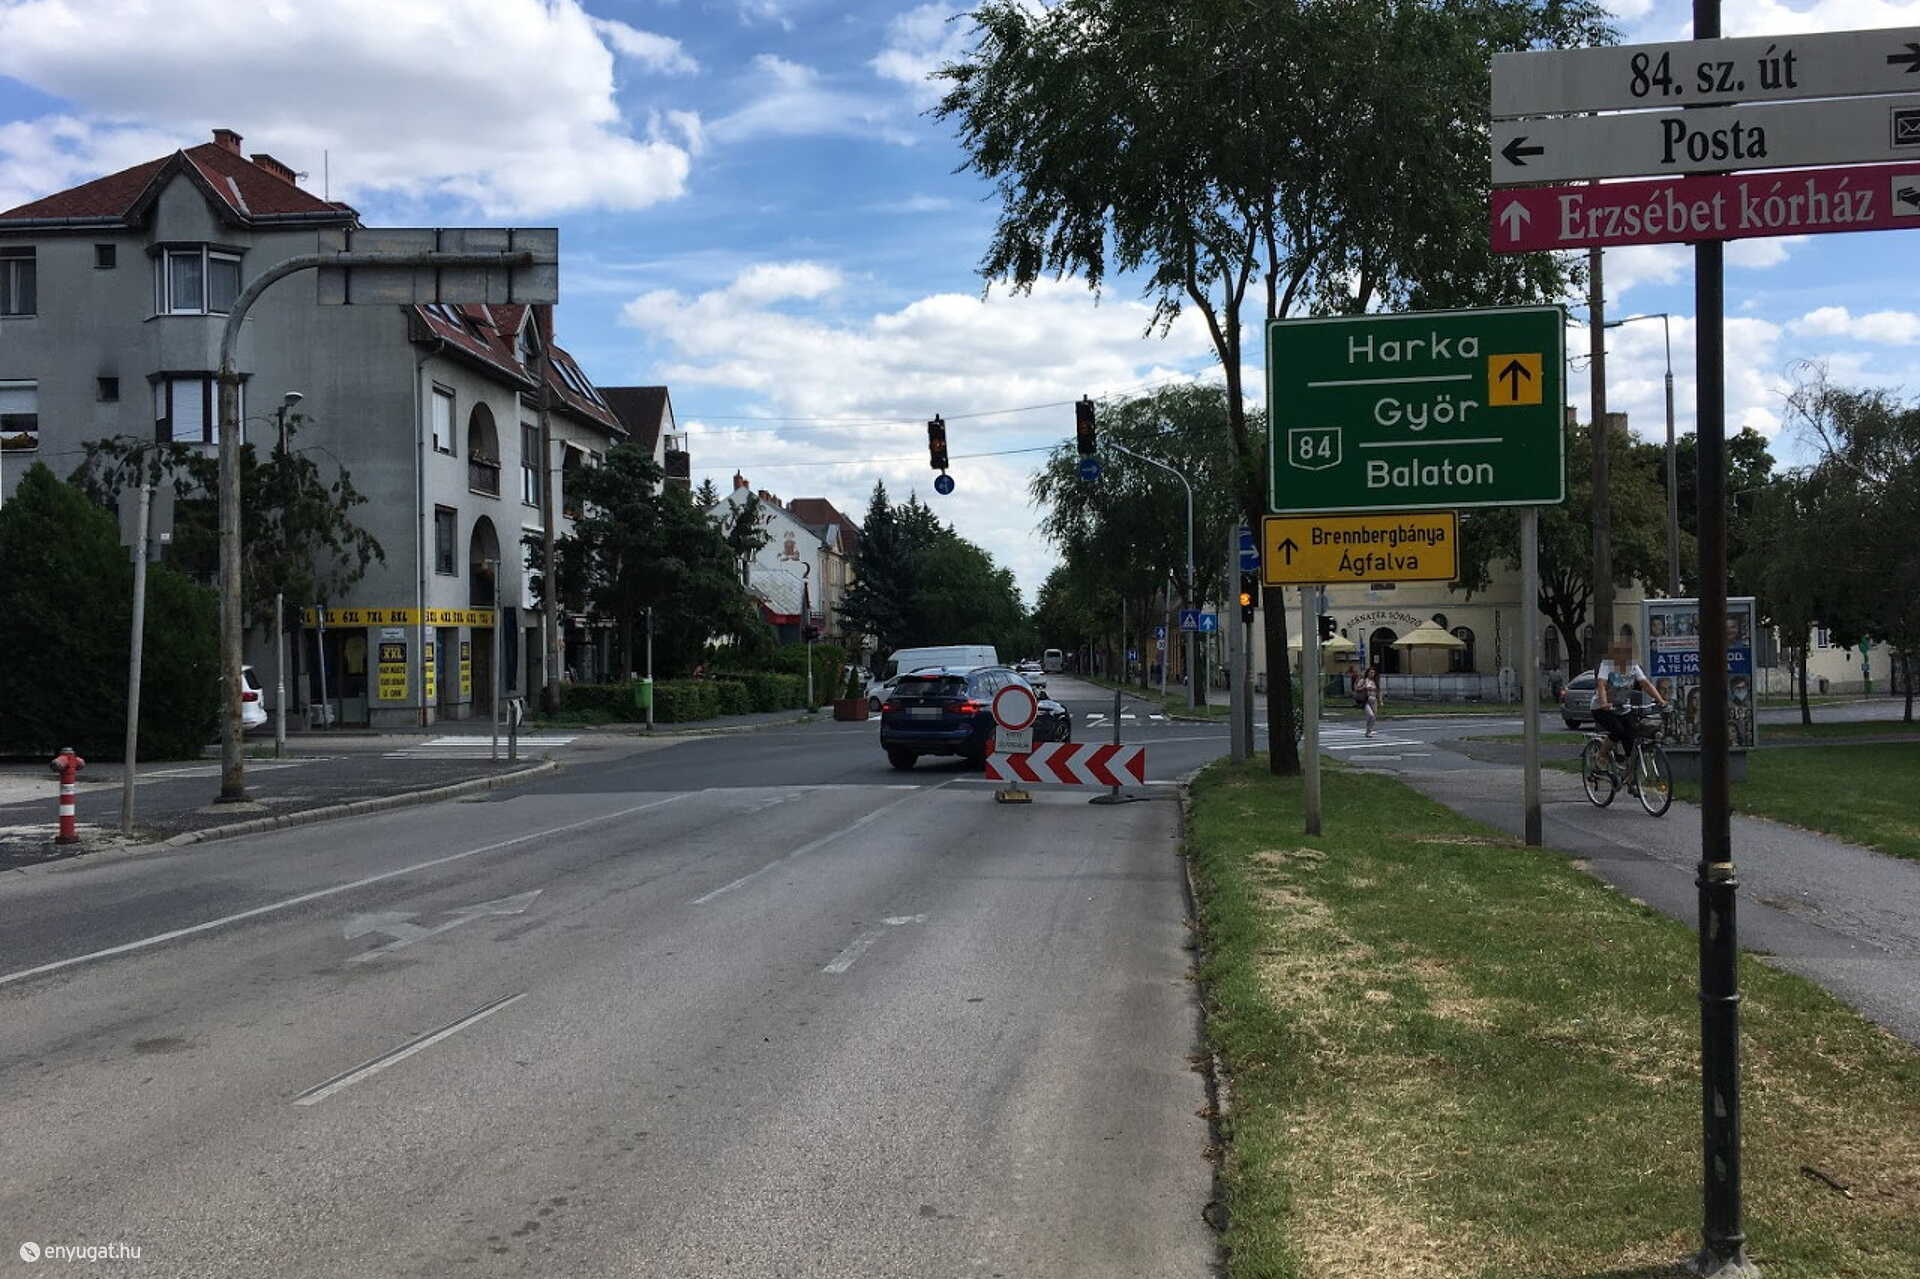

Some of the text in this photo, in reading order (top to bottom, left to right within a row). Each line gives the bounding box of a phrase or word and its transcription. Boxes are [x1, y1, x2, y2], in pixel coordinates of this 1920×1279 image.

[1630, 44, 1797, 98] 84. sz. út
[1661, 118, 1767, 164] Posta
[1558, 176, 1874, 241] Erzsébet kórház
[1348, 331, 1479, 364] Harka
[1299, 435, 1331, 460] 84
[1367, 458, 1494, 489] Balaton
[1312, 524, 1445, 548] Brennbergbánya
[1339, 550, 1419, 573] Ágfalva
[342, 611, 359, 623] 6XL
[367, 611, 383, 622] 7XL
[1657, 654, 1667, 663] A
[1668, 654, 1681, 663] TE
[1658, 665, 1667, 673] A
[1668, 665, 1681, 673] TE
